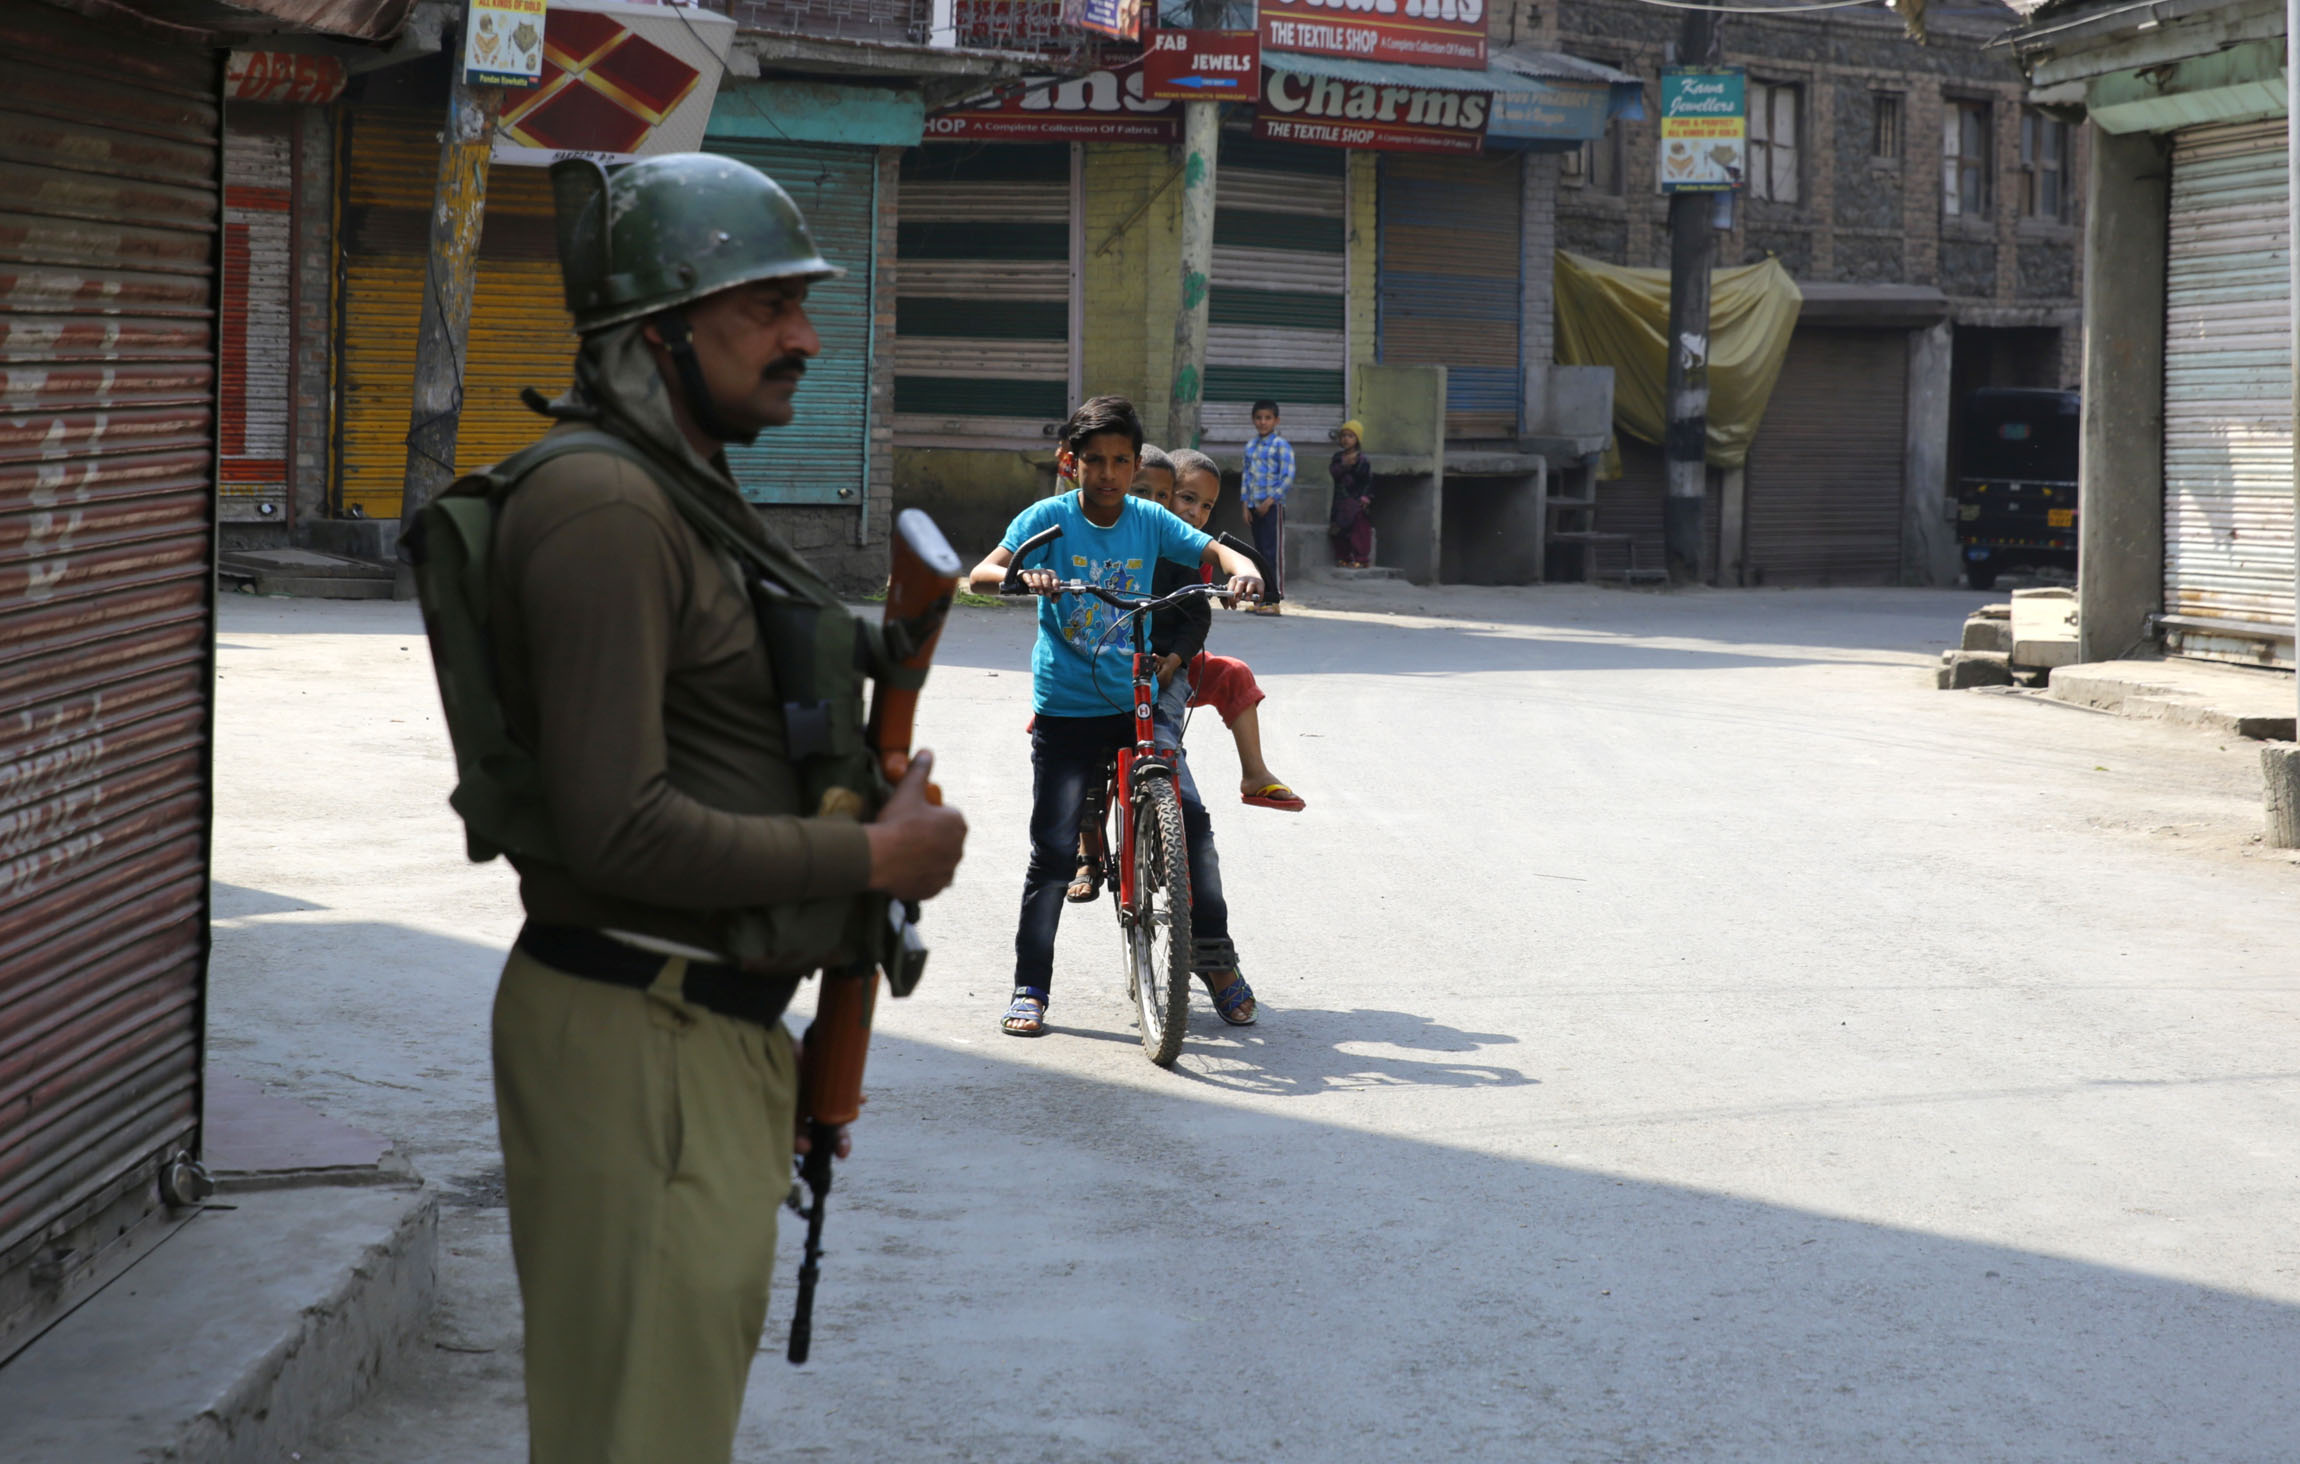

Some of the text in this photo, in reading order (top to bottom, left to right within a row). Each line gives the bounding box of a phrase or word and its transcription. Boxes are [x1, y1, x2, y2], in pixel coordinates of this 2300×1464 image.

[1155, 34, 1187, 51] FAB
[1270, 21, 1295, 46] THE
[1297, 23, 1344, 50] TEXTILE
[1345, 27, 1378, 53] SHOP
[1191, 53, 1251, 71] JEWELS
[1267, 70, 1486, 129] Charms
[1669, 96, 1735, 117] Jewellers
[973, 122, 983, 131] A
[985, 122, 1038, 134] Complete
[1040, 123, 1098, 134] Collection
[1100, 124, 1116, 134] Of
[1117, 125, 1159, 135] Fabrics
[1267, 121, 1291, 137] THE
[1293, 123, 1340, 141] TEXTILE
[1341, 128, 1375, 144] SHOP
